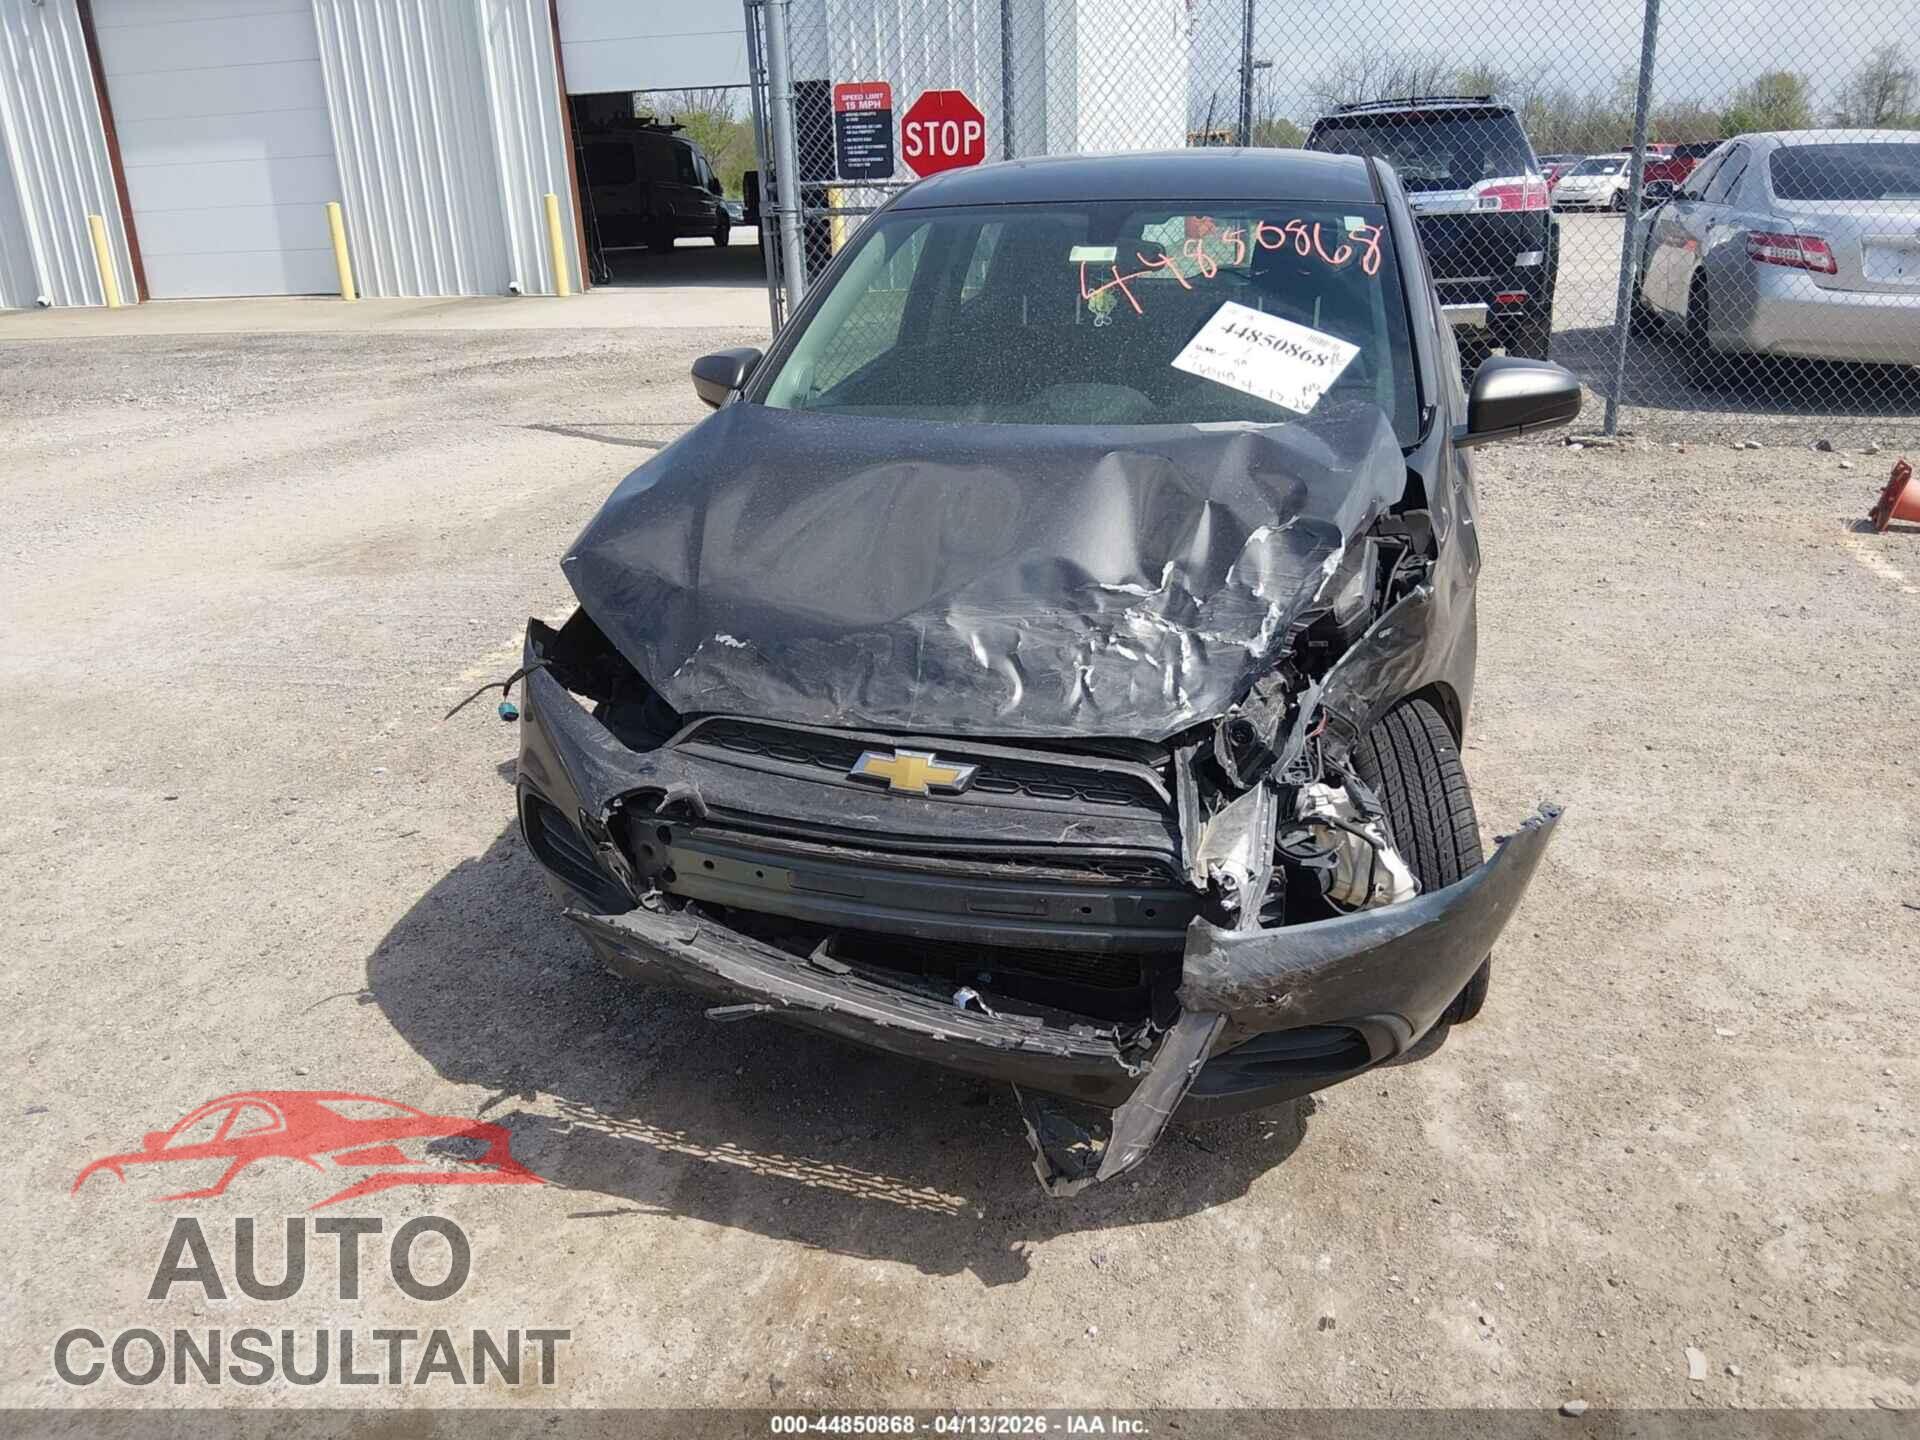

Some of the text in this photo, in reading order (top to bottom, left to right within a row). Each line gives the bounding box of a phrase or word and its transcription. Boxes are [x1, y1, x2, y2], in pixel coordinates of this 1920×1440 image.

[845, 100, 881, 110] 15 MPH
[865, 92, 884, 100] LIMIT
[906, 120, 981, 157] STOP
[1079, 215, 1385, 315] 44850868
[1220, 322, 1329, 367] 44850868
